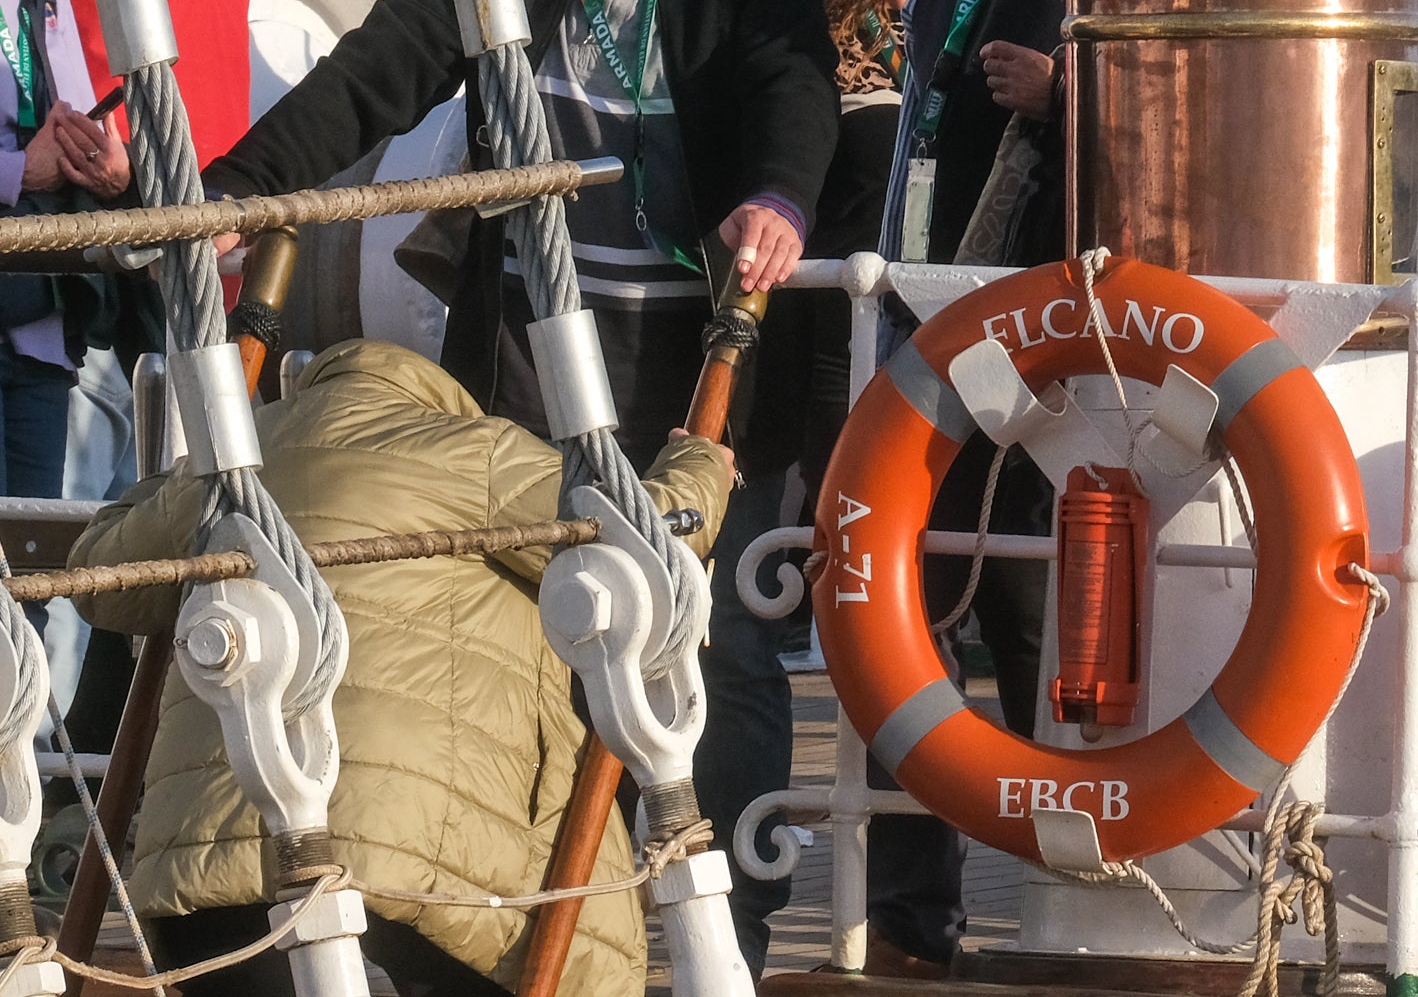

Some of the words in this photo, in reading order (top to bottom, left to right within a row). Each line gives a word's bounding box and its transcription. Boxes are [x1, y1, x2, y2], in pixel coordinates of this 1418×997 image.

[592, 10, 632, 89] ARMADA
[982, 298, 1205, 354] ELCANO
[835, 490, 872, 609] A-71
[997, 777, 1130, 821] EBCB
